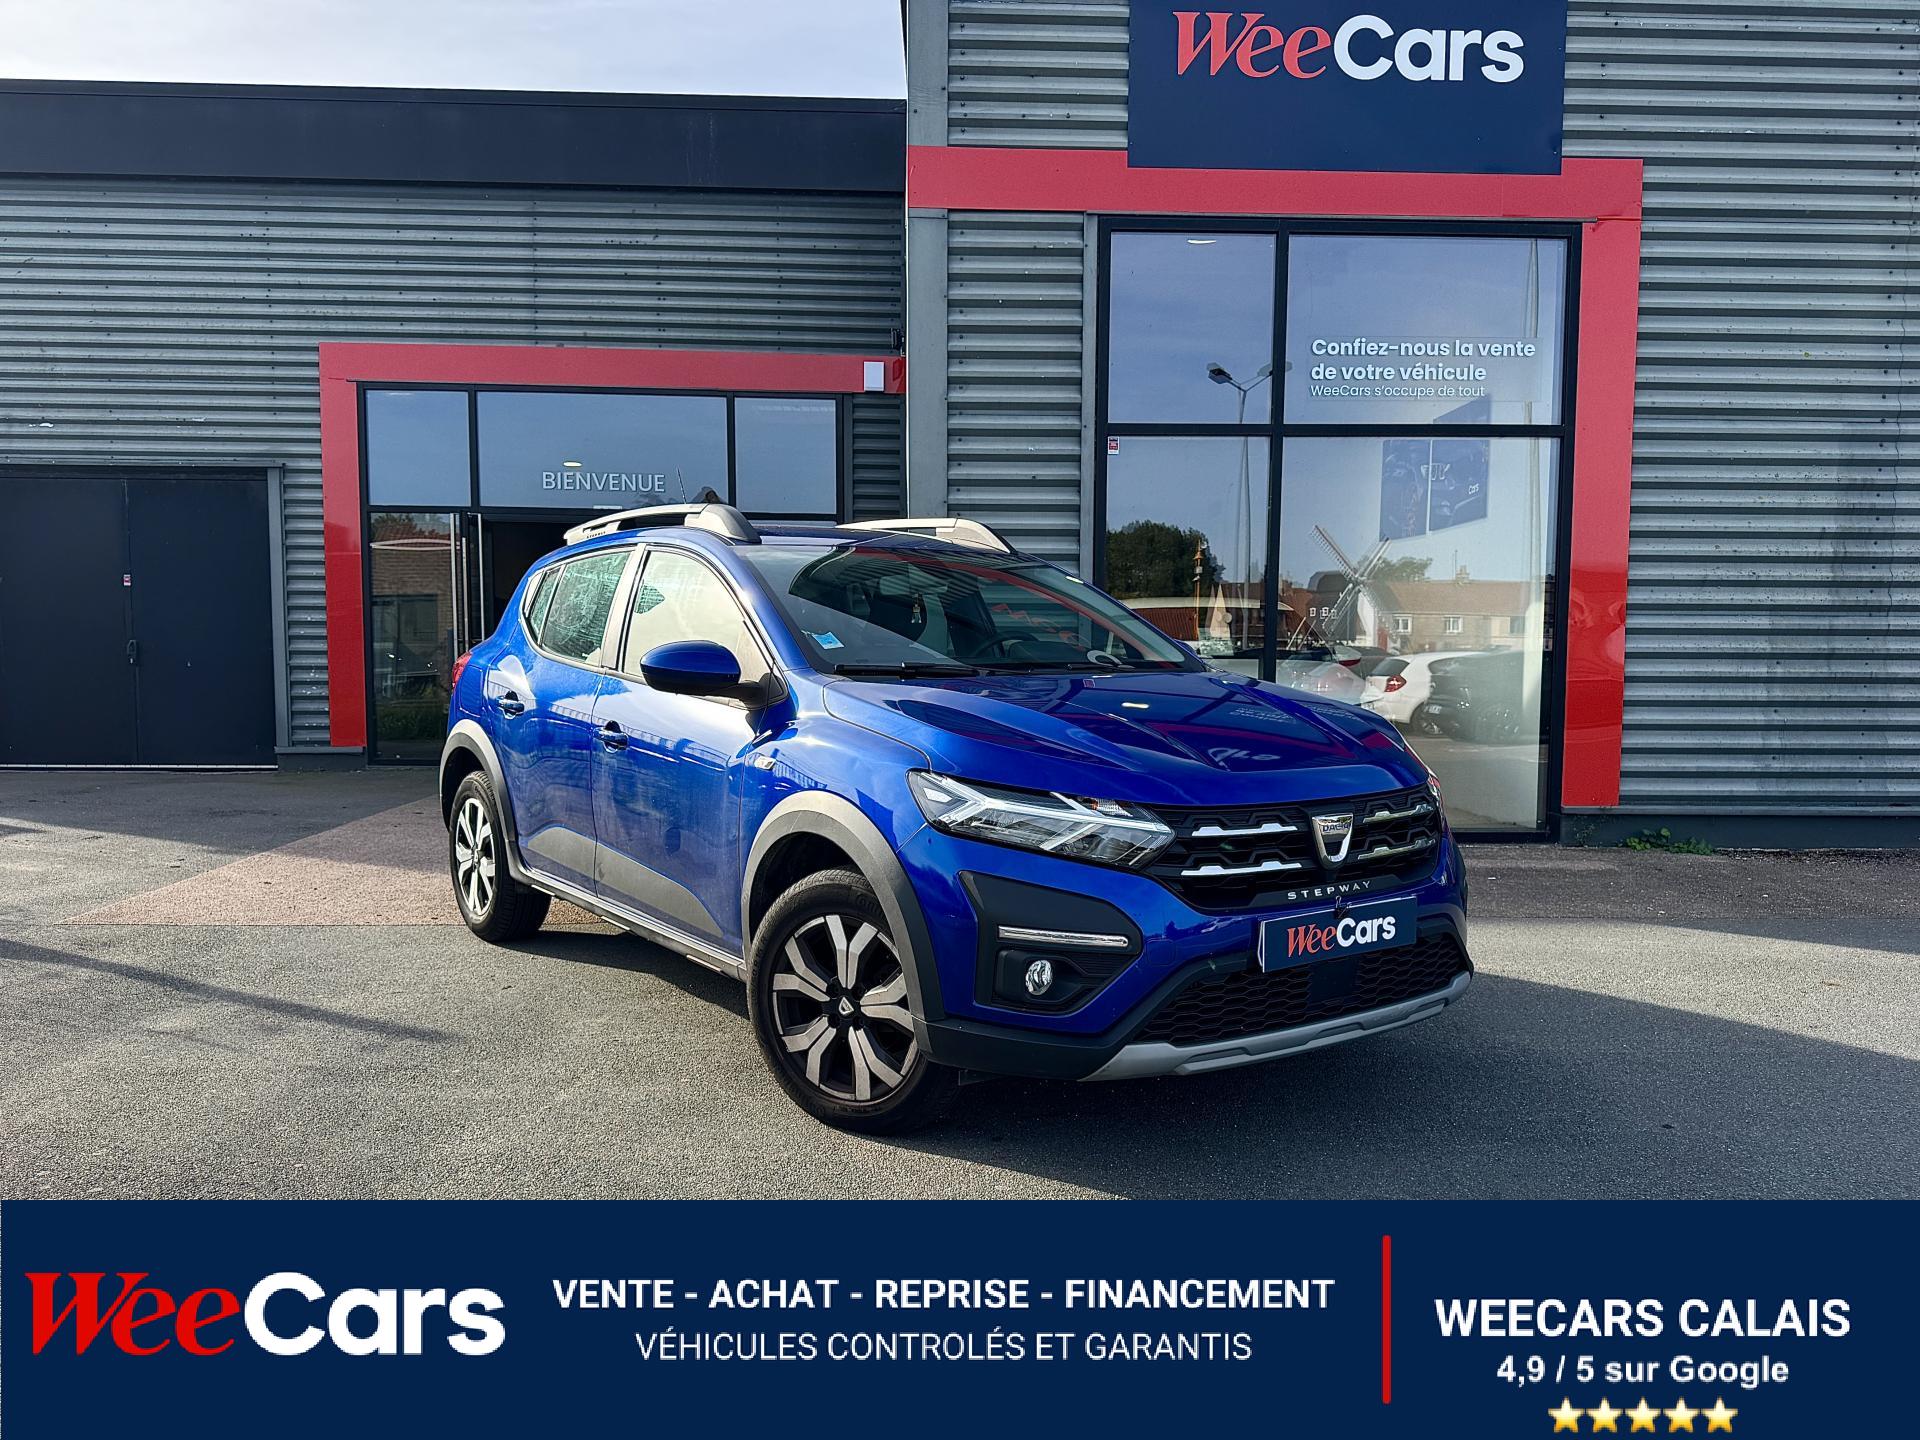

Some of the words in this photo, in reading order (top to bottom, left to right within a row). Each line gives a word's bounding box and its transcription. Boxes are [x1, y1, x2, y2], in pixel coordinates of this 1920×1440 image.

[1173, 11, 1525, 83] WeeCars
[1311, 338, 1450, 356] Confiez-nous
[1455, 340, 1474, 356] la
[1478, 341, 1536, 357] vente
[1311, 363, 1337, 381] de
[1342, 366, 1396, 381] votre
[1399, 362, 1487, 381] véhicule
[1310, 385, 1371, 397] WeeCars
[1438, 384, 1455, 397] de
[1458, 385, 1486, 397] tout
[541, 470, 666, 493] BIENVENUE
[1287, 880, 1373, 901] STEPWAY
[1286, 916, 1397, 959] WeeCars
